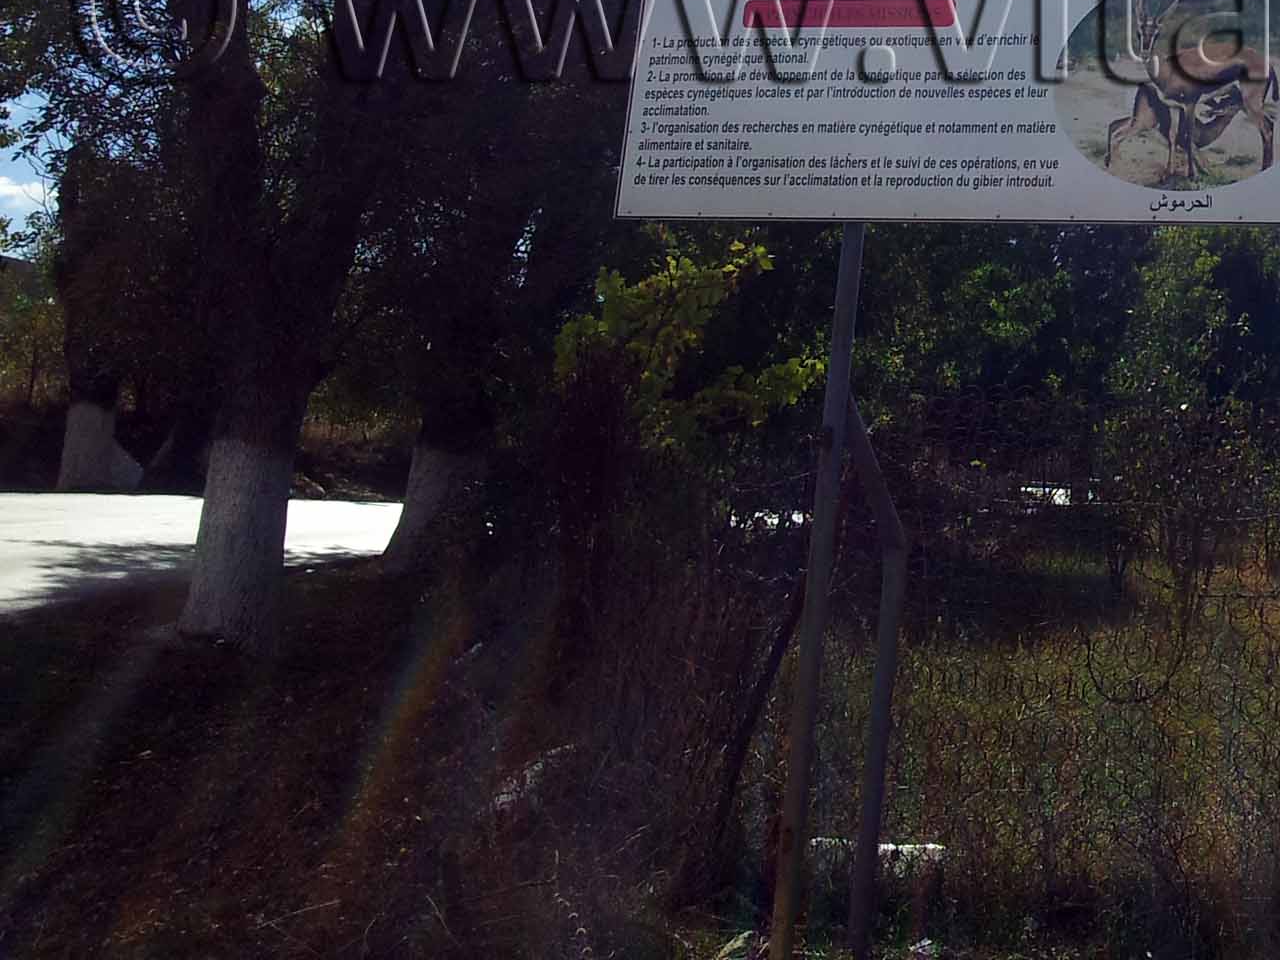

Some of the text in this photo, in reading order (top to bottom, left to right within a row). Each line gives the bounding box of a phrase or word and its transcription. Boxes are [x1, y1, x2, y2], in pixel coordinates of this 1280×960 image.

[663, 37, 676, 49] La
[733, 35, 750, 48] des
[869, 36, 883, 47] ou
[940, 36, 951, 46] en
[1030, 33, 1041, 46] le
[649, 53, 701, 67] patrimoine
[646, 70, 657, 83] 2-
[658, 70, 671, 82] La
[725, 70, 736, 82] et
[831, 68, 845, 81] de
[846, 68, 855, 81] la
[924, 70, 941, 84] par
[957, 67, 1004, 82] sélection
[1007, 67, 1027, 81] des
[644, 85, 1049, 101] espèces cynégétiques locales et par l'introduction de nouvelles espèces et leur
[643, 103, 710, 117] acclimatation.
[640, 120, 1056, 137] 3- l'organisation des recherches en matière cynégétique et notamment en matière
[638, 138, 752, 151] alimentaire et sanitaire.
[635, 155, 646, 168] 4-
[648, 155, 660, 168] La
[662, 155, 725, 171] participation
[726, 155, 734, 168] à
[735, 155, 806, 172] l'organisation
[808, 155, 827, 169] des
[870, 156, 881, 169] et
[883, 156, 893, 169] le
[894, 155, 921, 169] suivi
[923, 156, 937, 169] de
[939, 158, 958, 169] ces
[960, 155, 1021, 172] opérations,
[1023, 158, 1037, 169] en
[1040, 158, 1059, 169] vue
[634, 173, 1054, 190] de tirer les conséquences sur l'acclimatation et la reproduction du gibier introduit.
